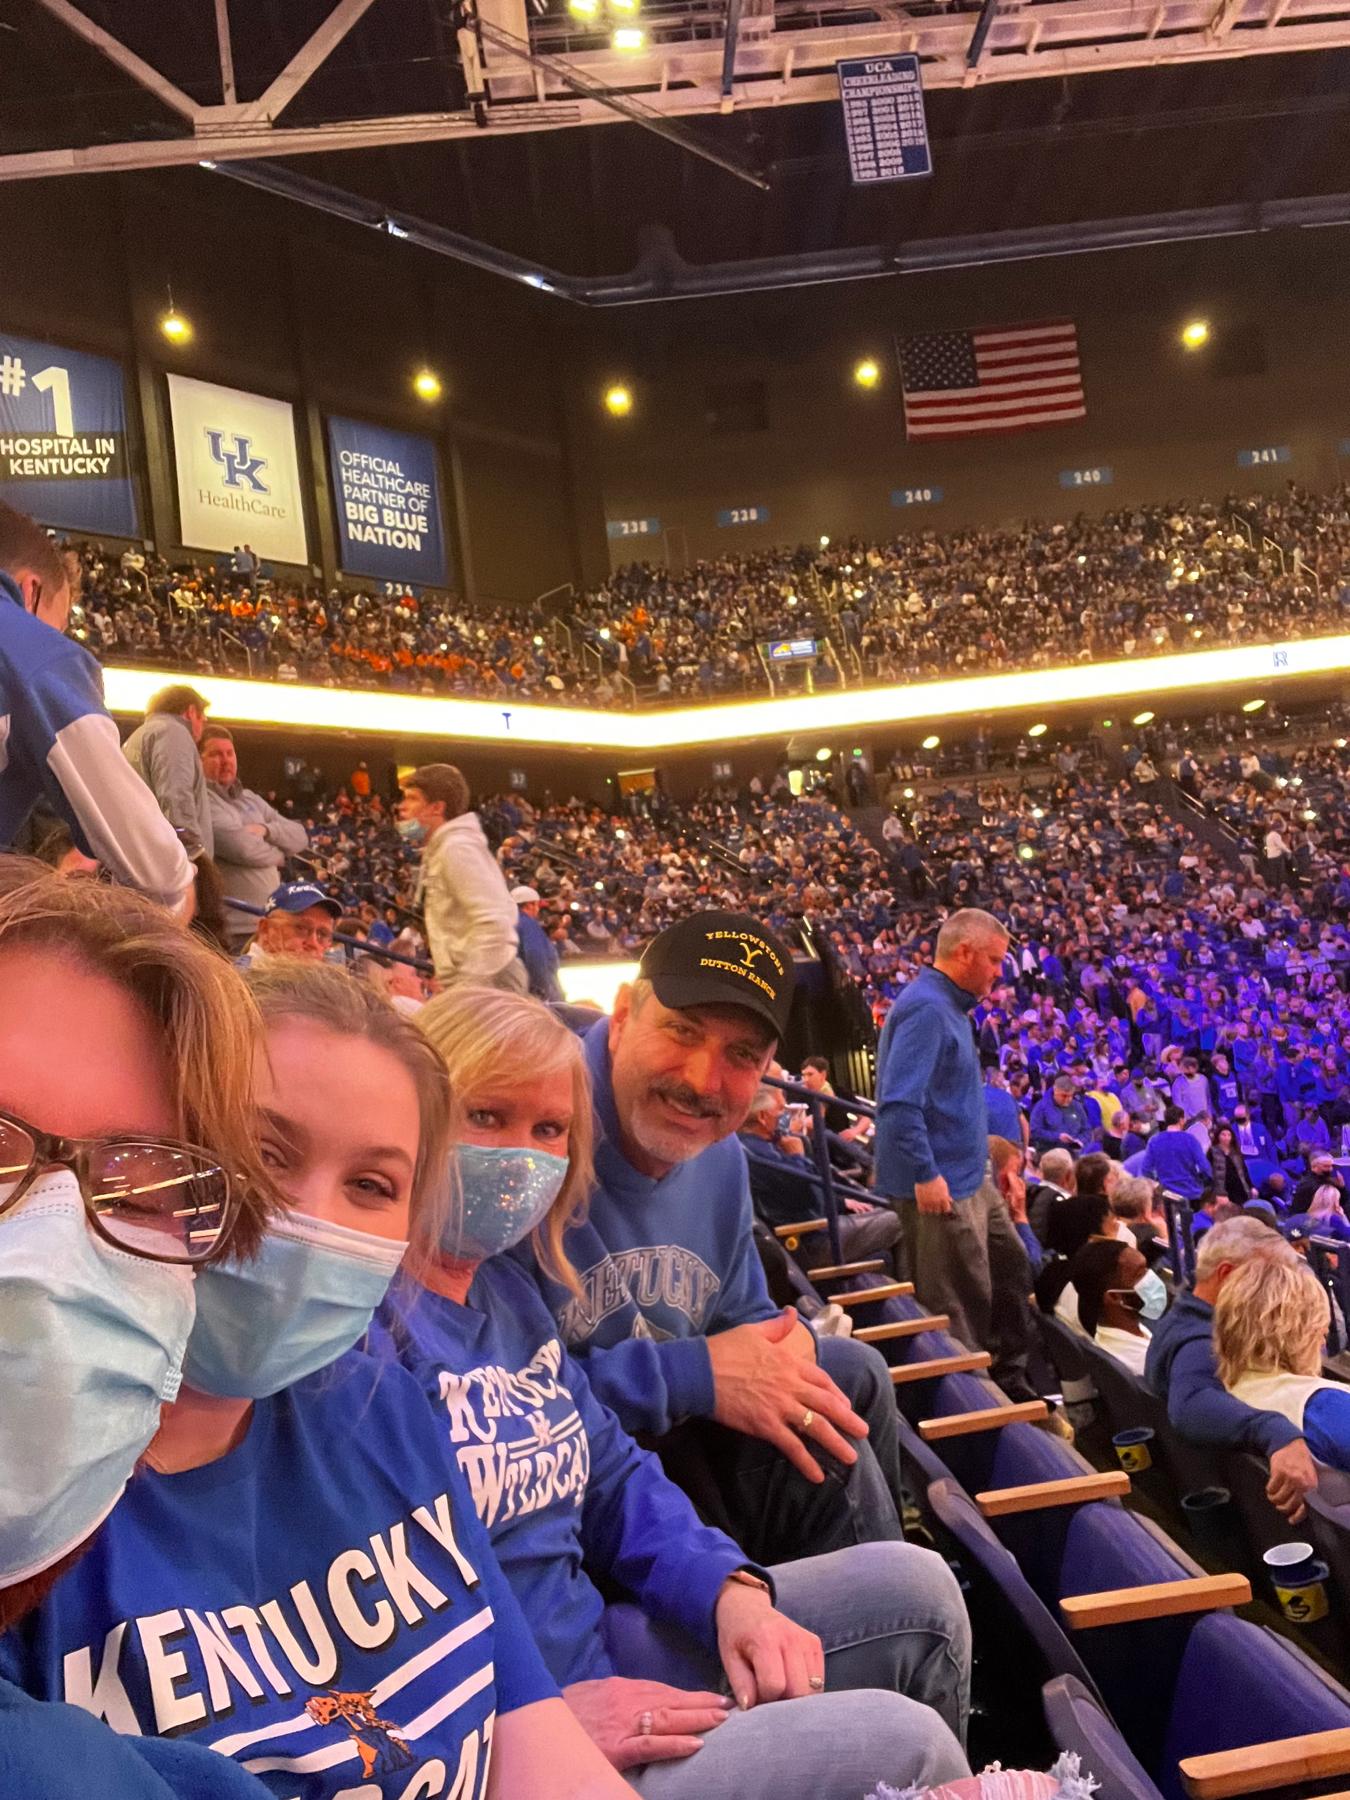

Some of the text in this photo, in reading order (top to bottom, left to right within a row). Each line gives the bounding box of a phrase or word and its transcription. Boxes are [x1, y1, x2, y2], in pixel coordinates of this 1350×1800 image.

[864, 62, 894, 73] UCA
[0, 438, 115, 455] HOSPITAL IN
[9, 457, 111, 475] KENTUCKY
[203, 427, 271, 496] UK
[340, 450, 405, 477] OFFICIAL
[341, 468, 431, 499] HEALTHCARE
[198, 489, 286, 519] HealthCare
[343, 484, 429, 513] PARTNER OF
[345, 501, 429, 534] BIG BLUE
[347, 522, 422, 552] NATION
[700, 958, 748, 978] DUTTON
[63, 1493, 480, 1737] KENTUCKY
